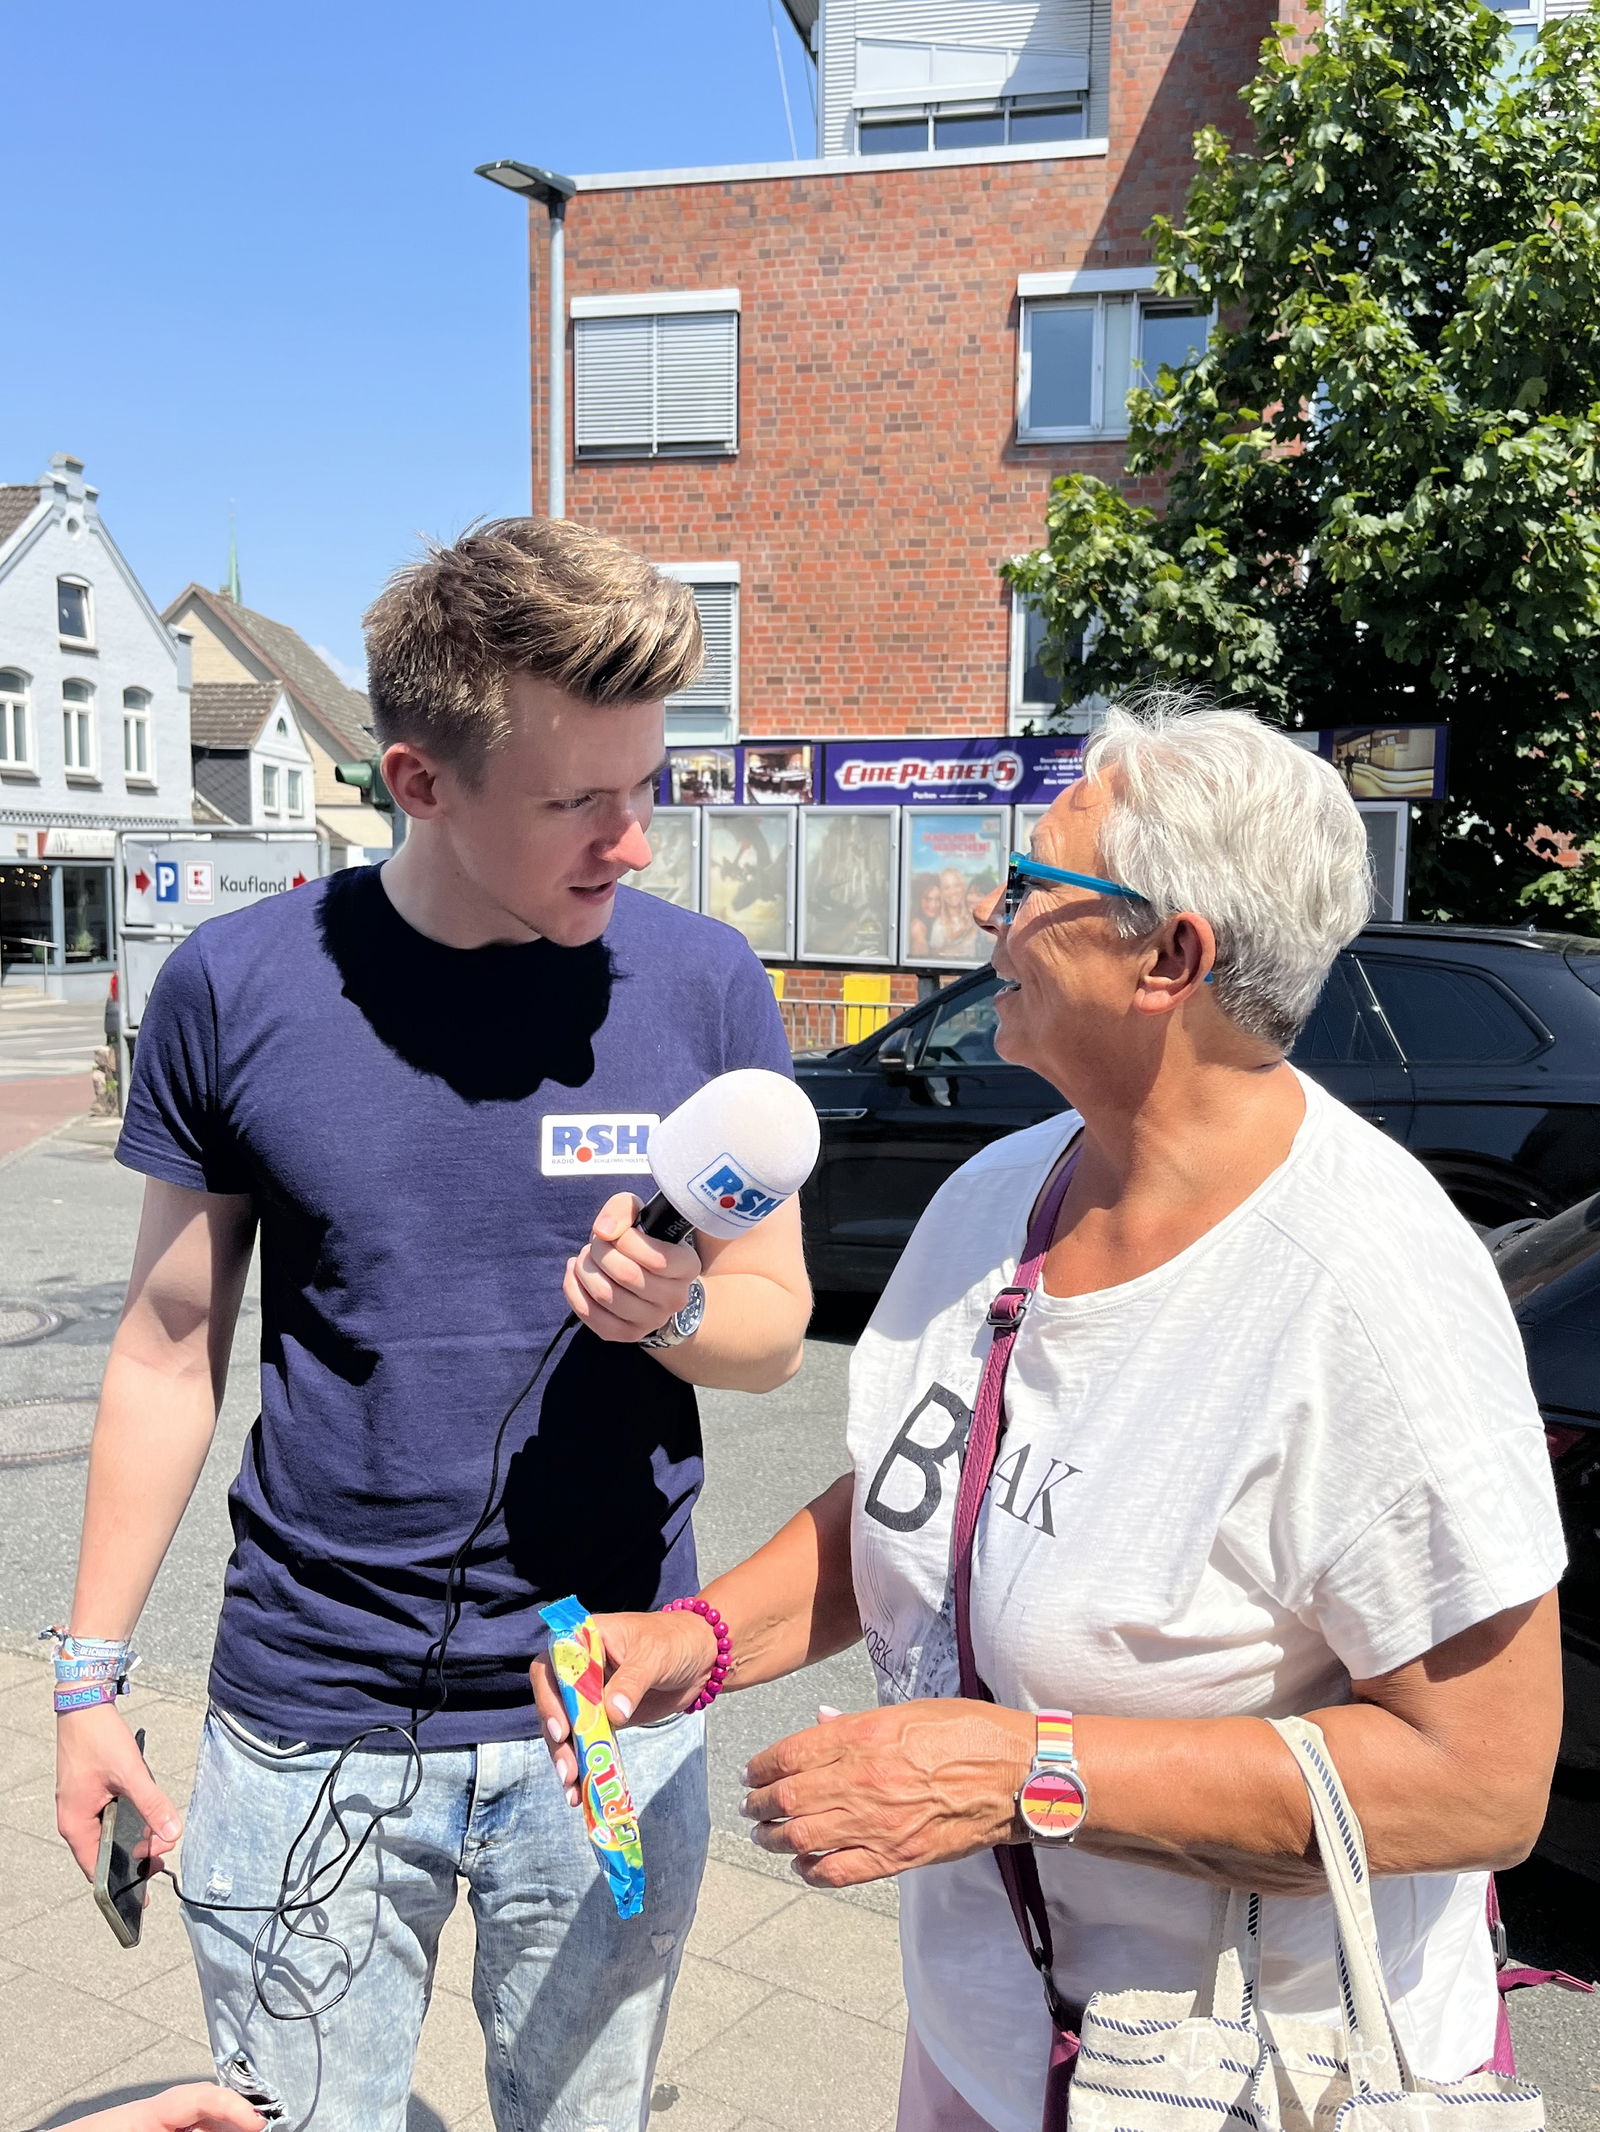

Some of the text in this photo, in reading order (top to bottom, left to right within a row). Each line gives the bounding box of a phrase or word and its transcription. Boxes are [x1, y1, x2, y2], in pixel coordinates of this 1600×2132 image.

[159, 866, 175, 898] P
[220, 875, 287, 893] Kaufland
[865, 1382, 1083, 1537] BAK
[57, 1687, 102, 1706] PRESS
